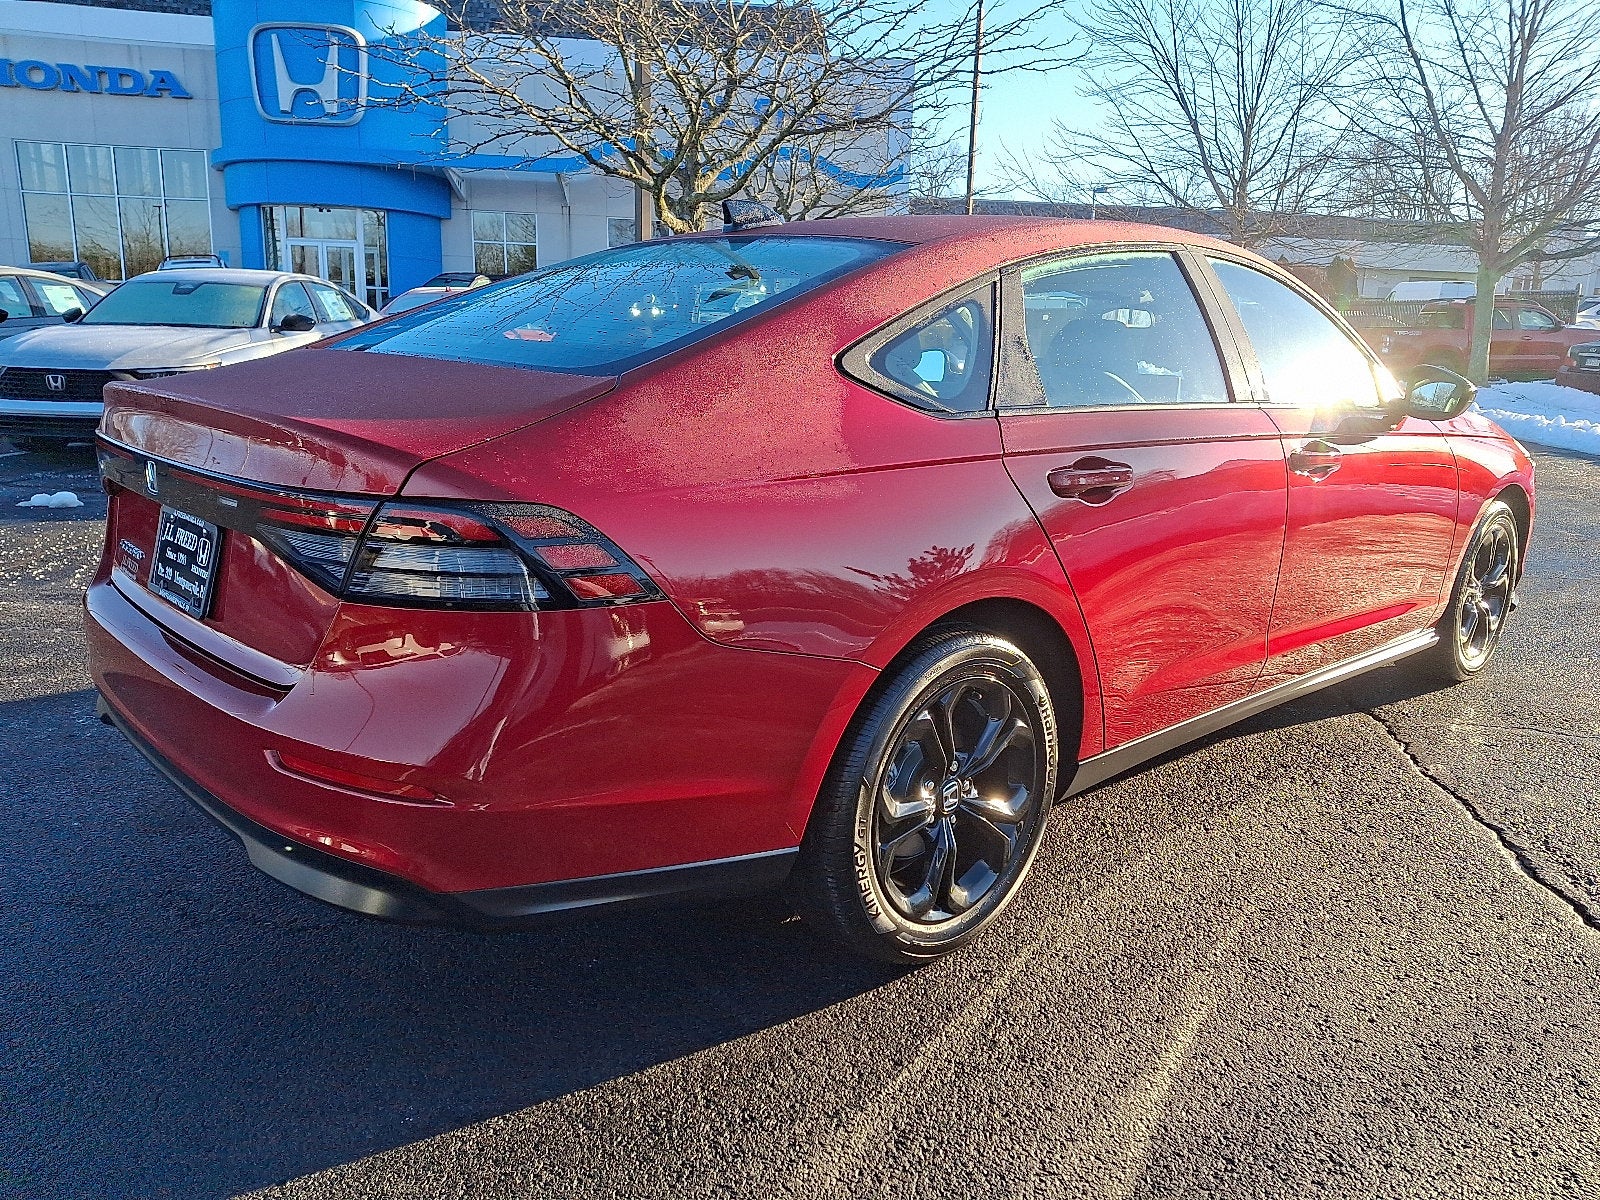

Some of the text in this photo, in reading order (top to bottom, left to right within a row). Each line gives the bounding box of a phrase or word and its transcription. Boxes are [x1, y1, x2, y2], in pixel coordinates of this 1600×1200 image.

[174, 527, 198, 552] FREED
[854, 816, 882, 919] KINERGY GT
